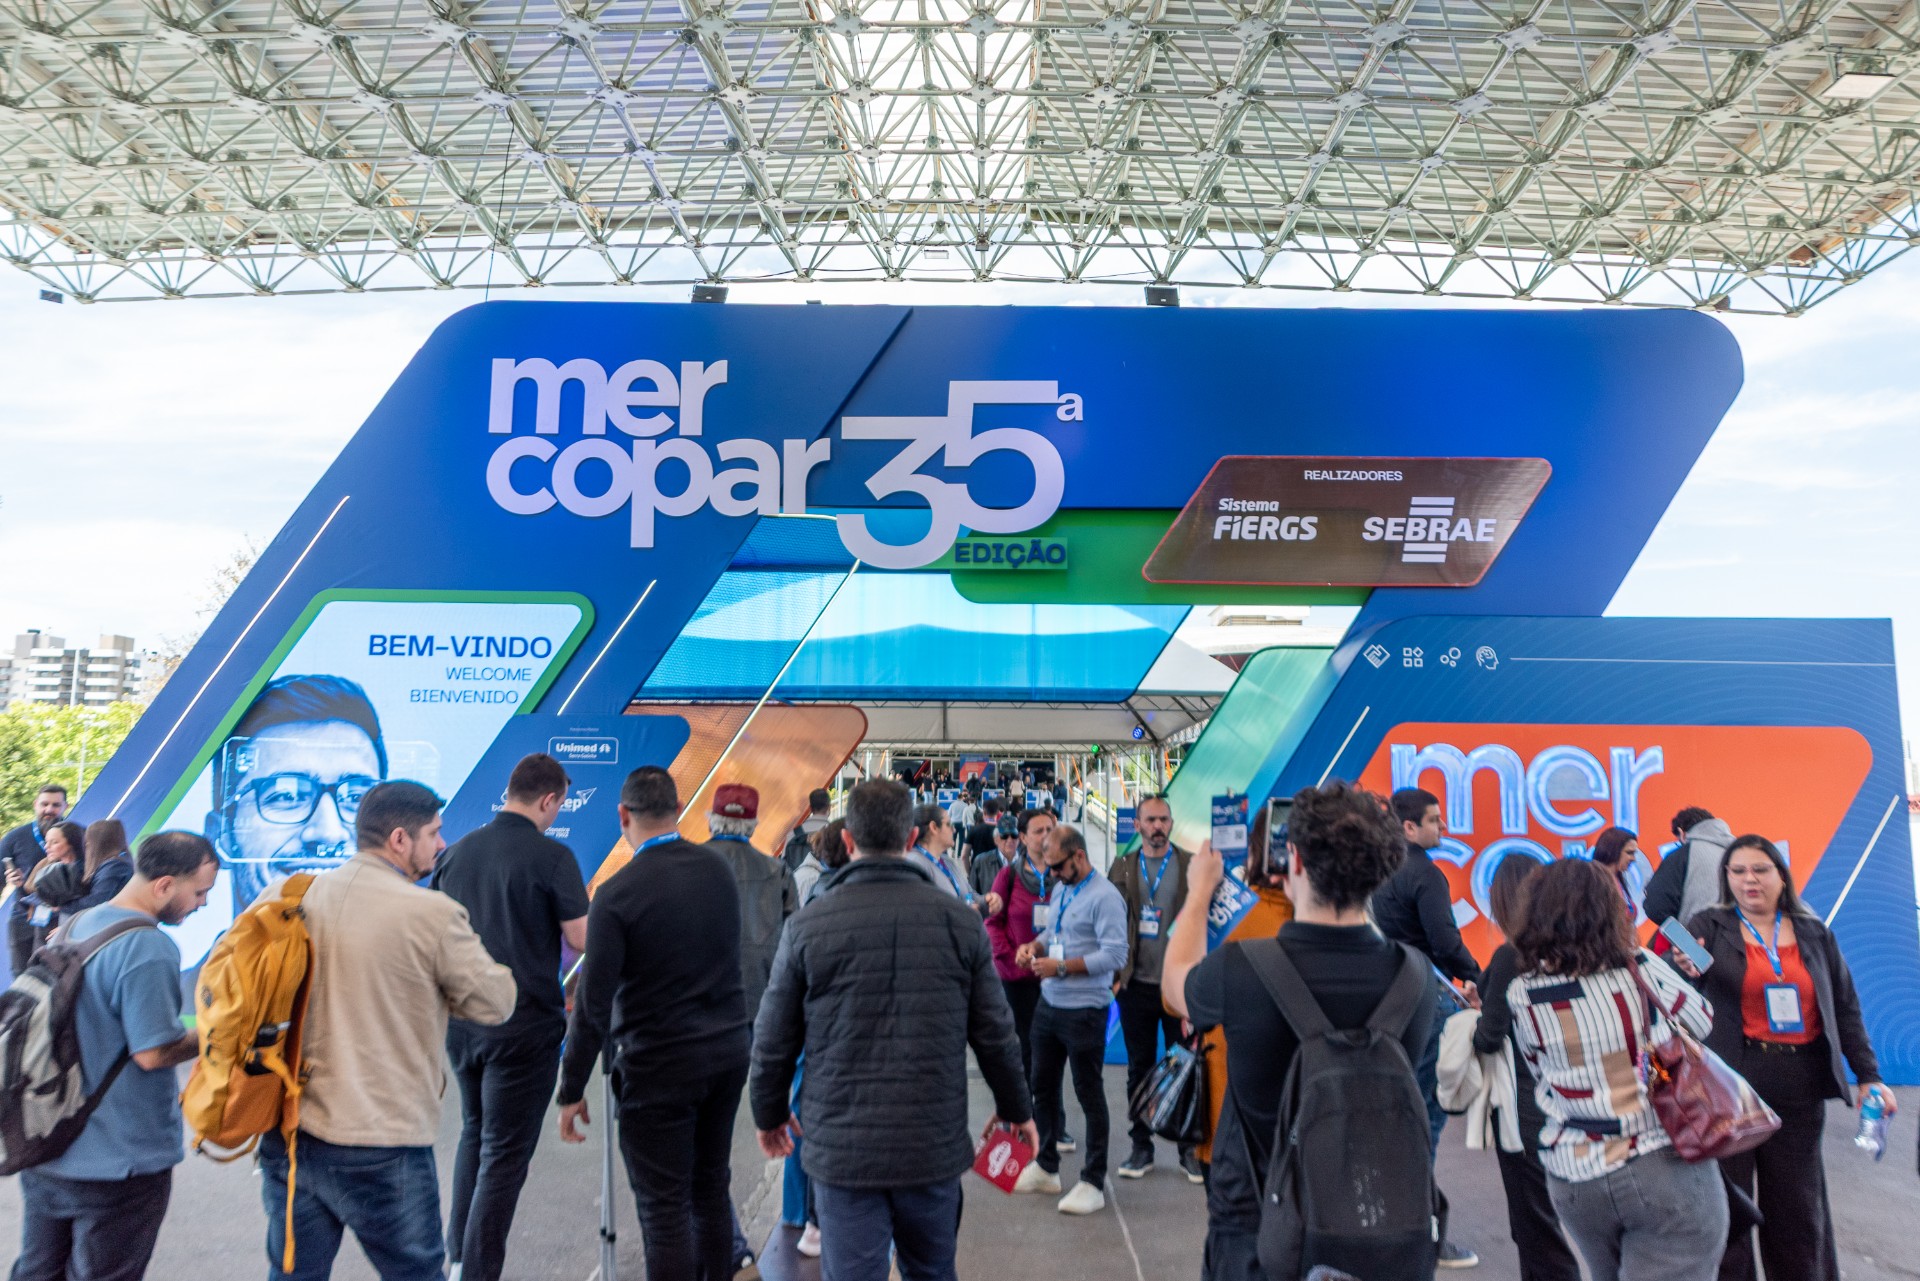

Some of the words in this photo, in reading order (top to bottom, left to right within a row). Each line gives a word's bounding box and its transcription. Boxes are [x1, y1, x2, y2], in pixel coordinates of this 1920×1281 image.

[487, 357, 729, 437] mer
[1304, 469, 1404, 482] REALIZADORES
[485, 435, 831, 549] copar
[1218, 497, 1280, 513] Sistema
[1362, 517, 1496, 542] SEBRAE
[954, 538, 1067, 569] EDIÇÃO
[368, 634, 552, 659] BEM-VINDO
[445, 666, 532, 682] WELCOME
[409, 689, 519, 704] BIENVENIDO
[555, 742, 598, 753] Unimed
[1390, 742, 1665, 837] mer
